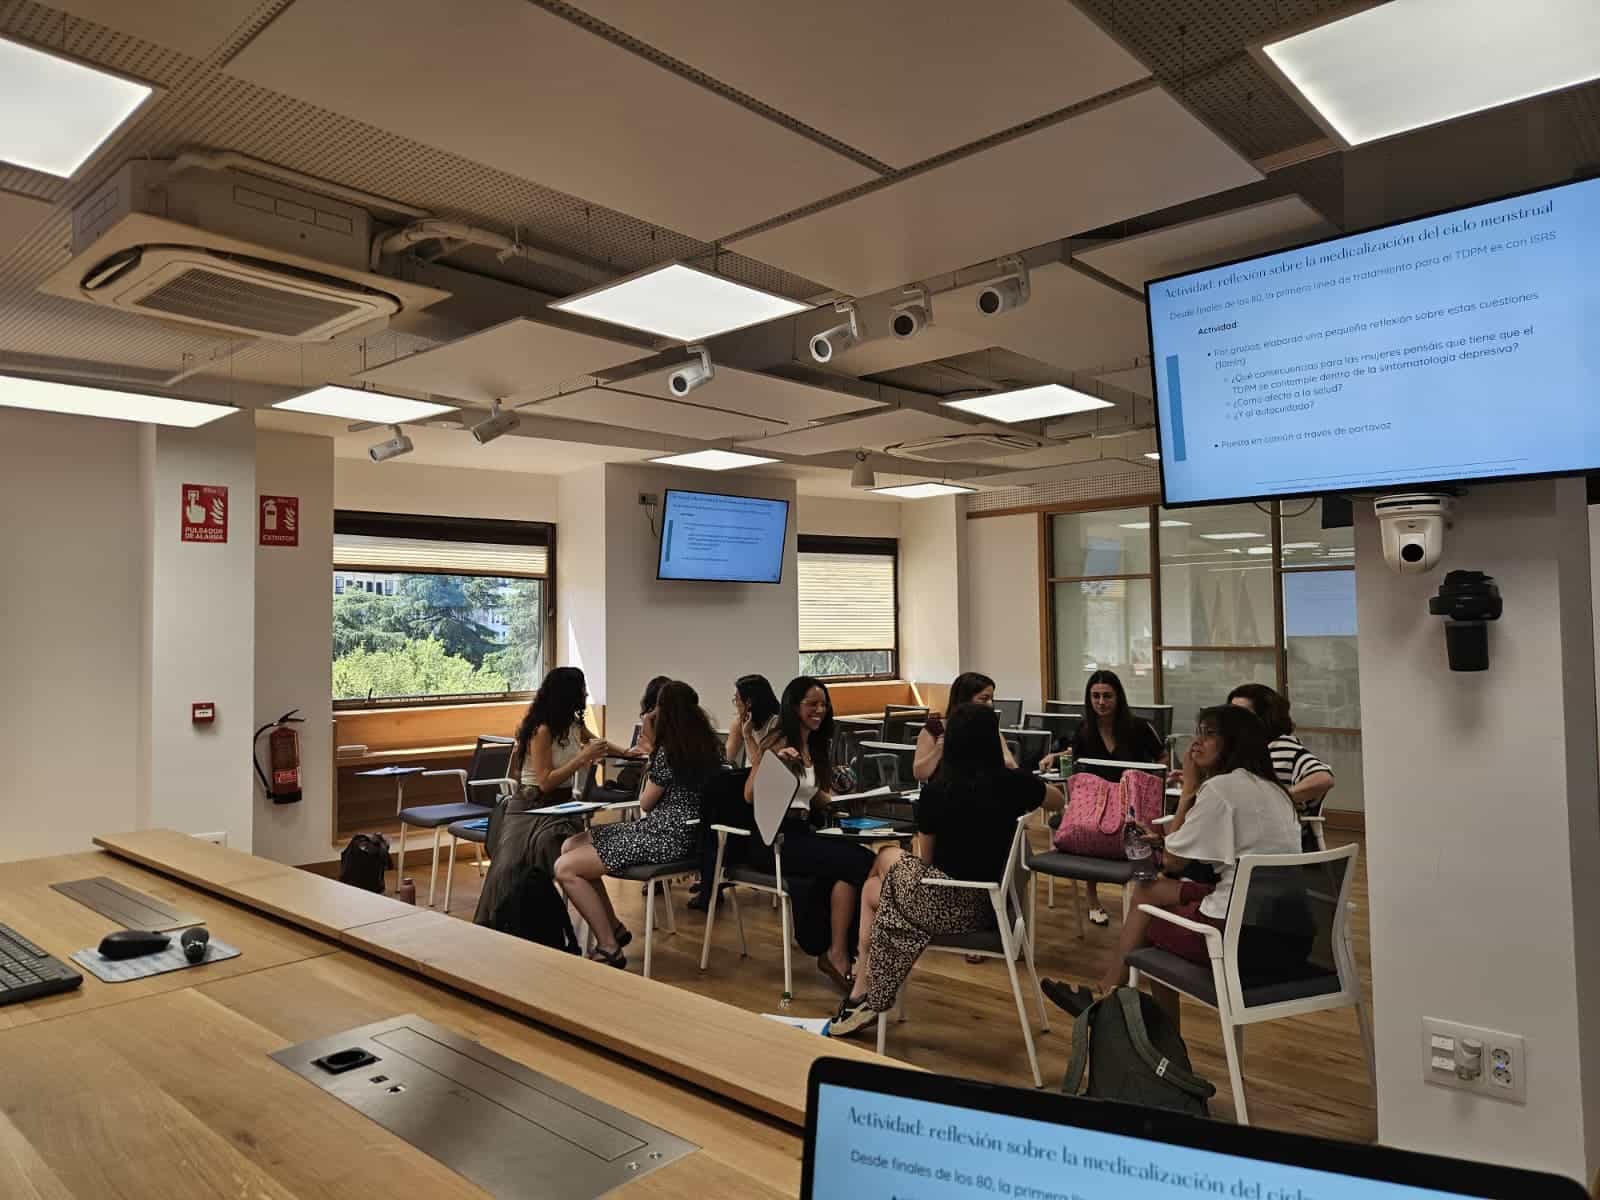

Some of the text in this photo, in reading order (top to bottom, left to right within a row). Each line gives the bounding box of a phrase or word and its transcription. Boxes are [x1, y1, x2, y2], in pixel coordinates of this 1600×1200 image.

[1164, 200, 1553, 299] Actividad: reflexión sobre la medicalización del ciclo menstrual
[1170, 308, 1195, 320] Desde
[1196, 301, 1222, 316] finales
[1225, 298, 1236, 308] de
[1237, 295, 1250, 306] los
[1276, 282, 1312, 299] primera
[1338, 271, 1351, 285] de
[1354, 260, 1413, 282] tratamiento
[1415, 256, 1441, 272] para
[1443, 252, 1452, 264] el
[1456, 244, 1488, 260] TDPM
[1490, 242, 1503, 254] es
[1506, 237, 1527, 249] con
[1214, 348, 1229, 358] Por
[1305, 330, 1323, 341] una
[1325, 322, 1368, 339] pequeña
[1369, 312, 1413, 329] reflexión
[1415, 308, 1444, 321] sobre
[1448, 301, 1477, 315] estas
[1479, 291, 1539, 310] cuestiones
[1232, 384, 1257, 395] TDPM
[1259, 380, 1269, 391] se
[1270, 375, 1318, 389] contemple
[1319, 367, 1351, 381] dentro
[1353, 364, 1366, 377] de
[1367, 362, 1377, 374] la
[1458, 341, 1520, 361] depresiva?
[1254, 362, 1319, 379] consecuencias
[1320, 357, 1343, 371] para
[1345, 352, 1360, 364] las
[1361, 347, 1401, 361] mujeres
[1403, 340, 1444, 357] pensáis
[1446, 336, 1467, 350] que
[1469, 332, 1496, 345] tiene
[1499, 328, 1520, 341] que
[1523, 325, 1534, 336] el
[1313, 383, 1343, 396] salud?
[1221, 438, 1250, 449] Puesta
[1334, 424, 1347, 436] de
[185, 526, 224, 535] PULSADOR
[848, 1105, 923, 1138] Actividad:
[929, 1124, 1002, 1152] reflexión
[1006, 1138, 1057, 1163] sobre
[1062, 1145, 1079, 1166] la
[1083, 1155, 1224, 1195] medicalización
[1230, 1177, 1261, 1200] del
[850, 1148, 889, 1170] Desde
[891, 1158, 932, 1180] finales
[935, 1165, 953, 1183] de
[954, 1169, 973, 1188] los
[976, 1173, 996, 1194] 80,
[998, 1178, 1011, 1195] la
